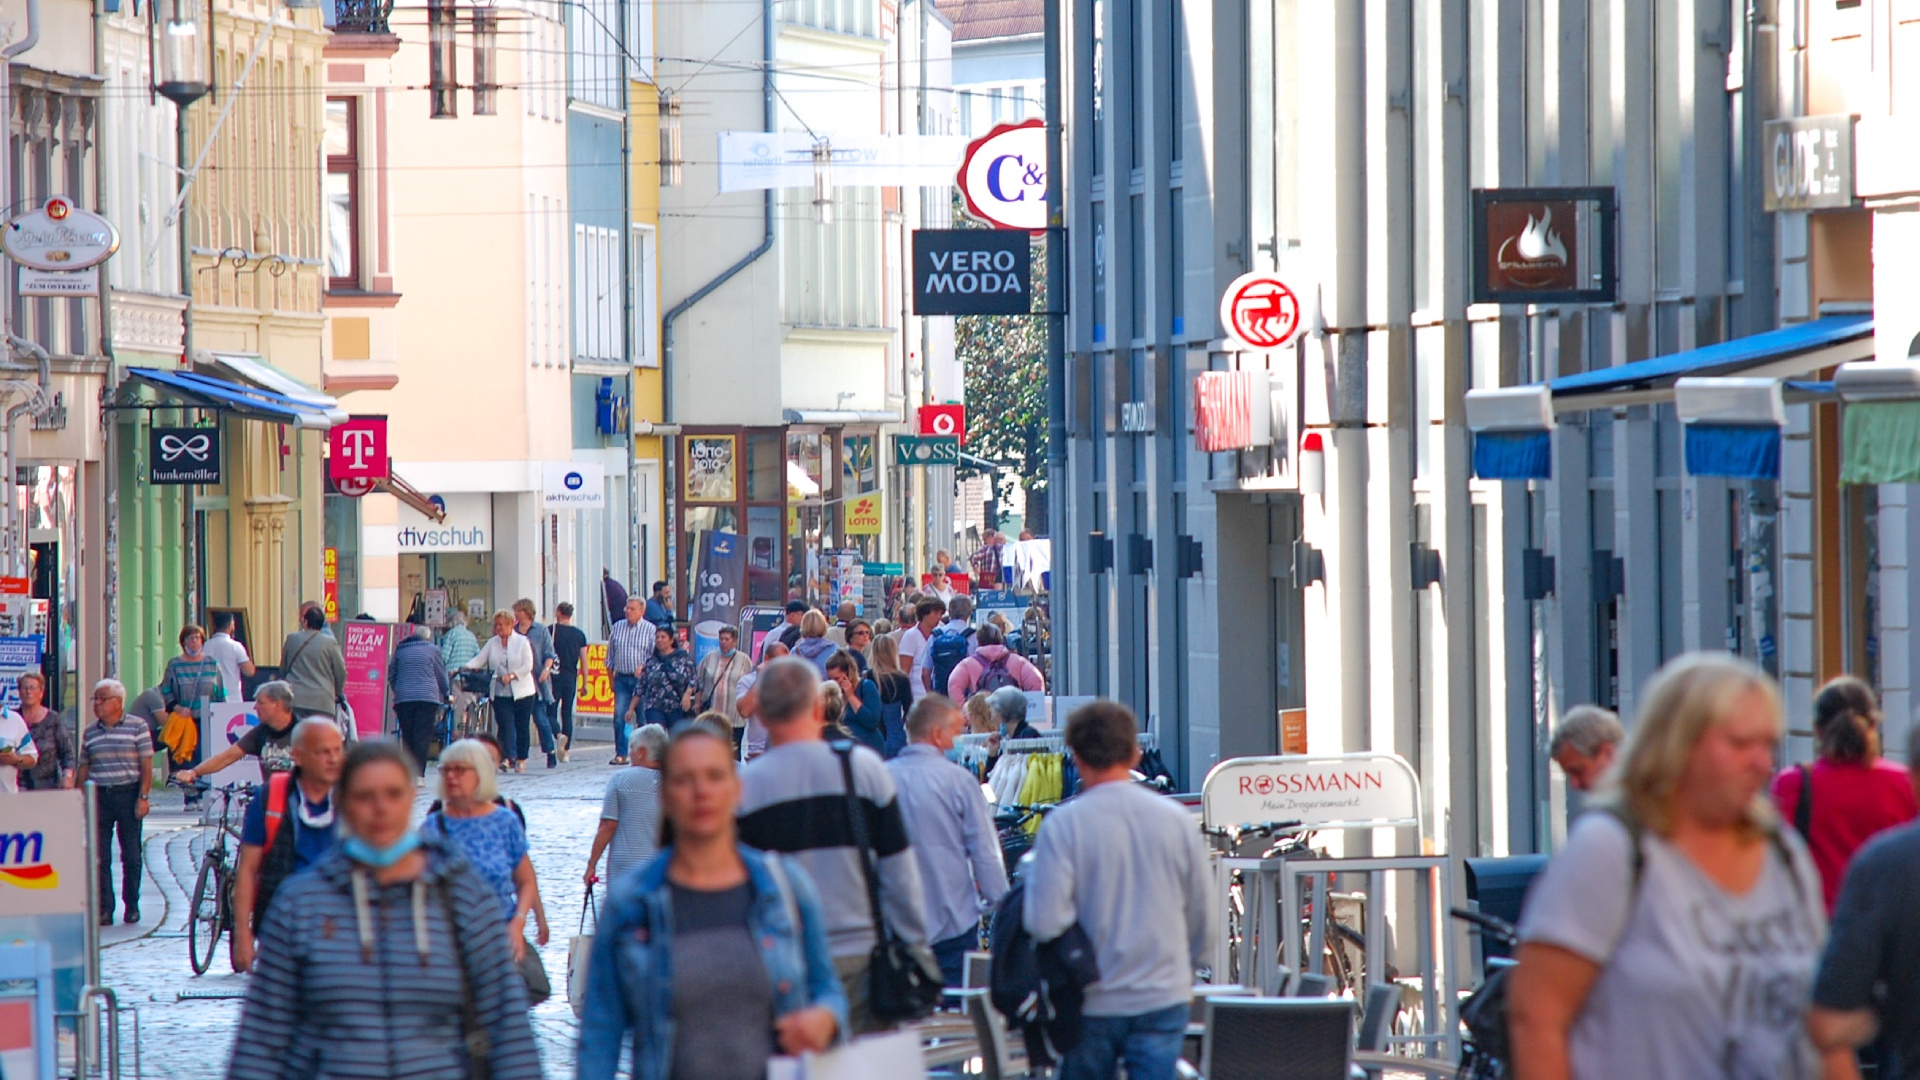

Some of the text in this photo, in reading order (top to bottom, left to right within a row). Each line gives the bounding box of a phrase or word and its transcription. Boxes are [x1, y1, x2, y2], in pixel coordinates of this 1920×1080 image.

[986, 154, 1048, 203] C&
[929, 250, 1015, 271] VERO
[925, 272, 1022, 293] MODA
[153, 468, 218, 480] hunkemöller
[545, 492, 601, 502] aktivschuh
[849, 517, 878, 526] LOTTO
[700, 569, 722, 587] to
[700, 588, 735, 612] go!
[347, 634, 384, 646] WLAN
[1239, 770, 1382, 795] ROSSMANN
[1261, 796, 1361, 813] Mein Drogeriemarkt
